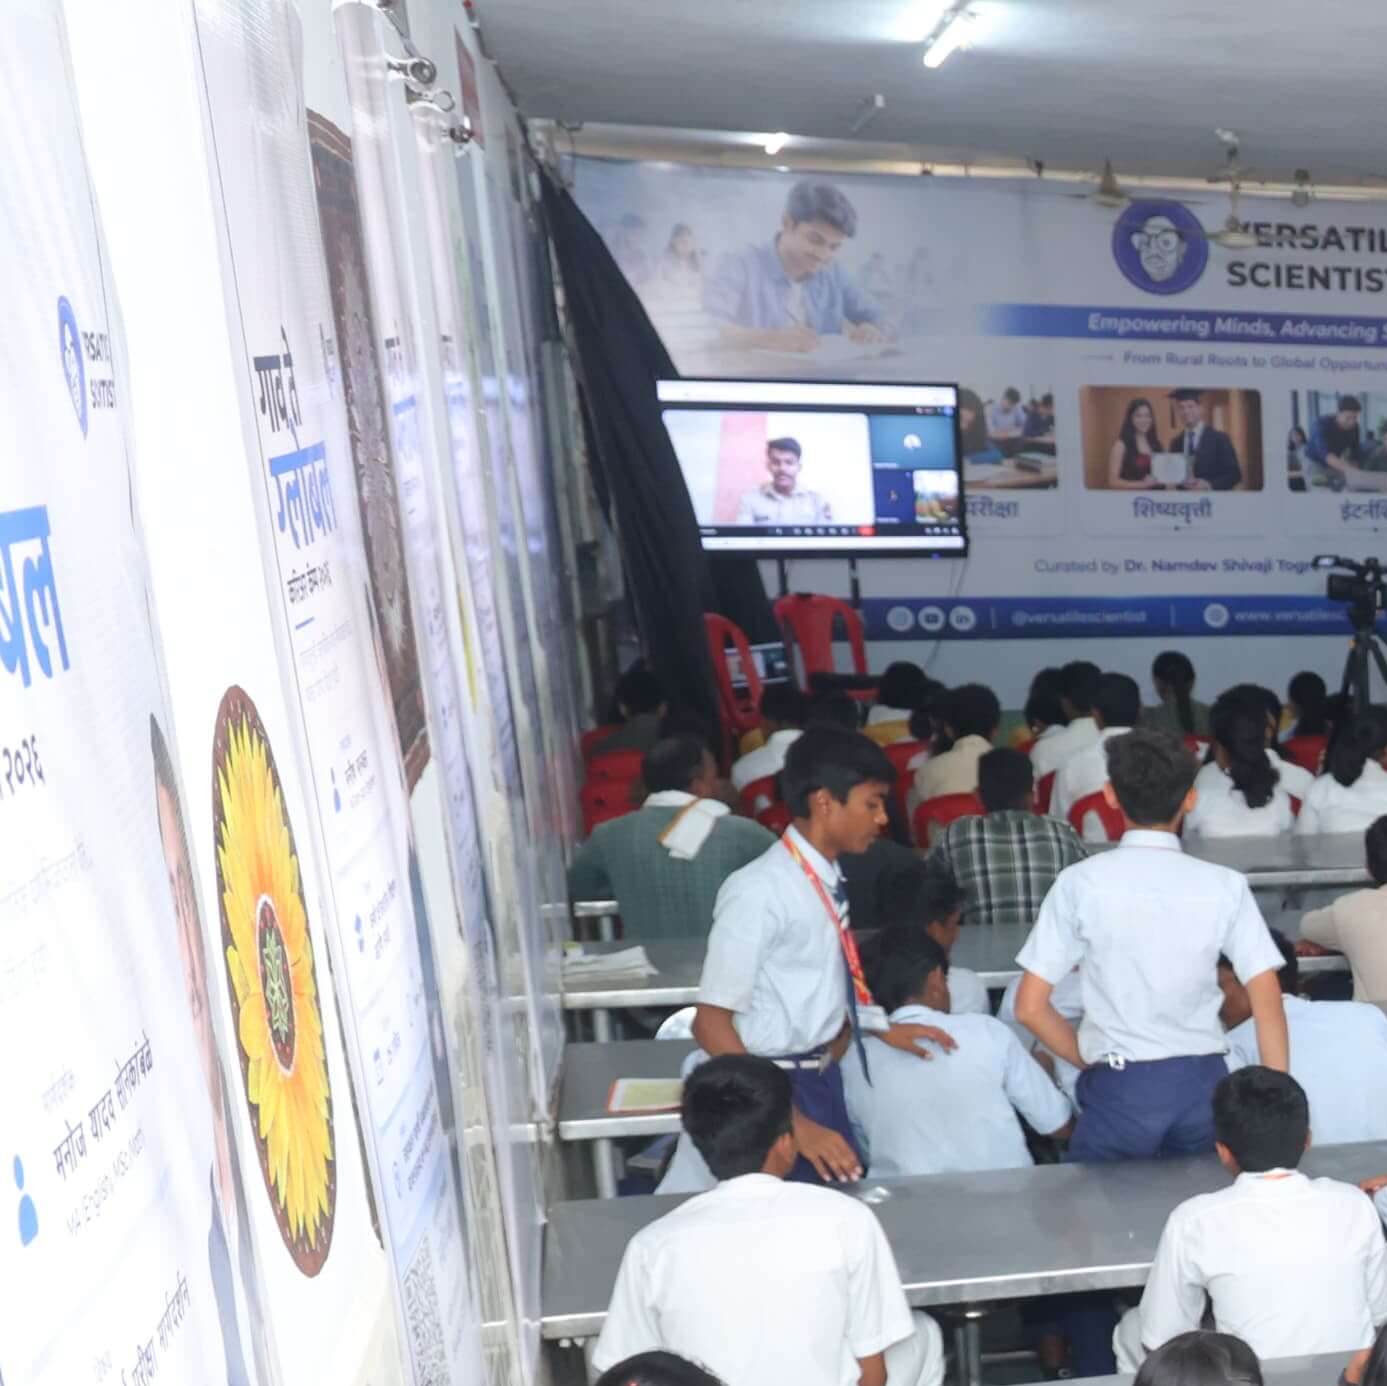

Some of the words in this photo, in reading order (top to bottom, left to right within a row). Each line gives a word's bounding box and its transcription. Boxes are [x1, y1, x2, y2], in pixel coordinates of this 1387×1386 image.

[1087, 312, 1210, 338] Empowering
[1214, 316, 1276, 337] Minds,
[1281, 319, 1378, 343] Advancing
[1123, 351, 1162, 365] From
[1165, 351, 1203, 366] Rural
[1207, 353, 1248, 368] Roots
[1252, 354, 1267, 368] to
[1271, 355, 1316, 370] Global
[252, 354, 290, 433] गाव
[267, 416, 338, 550] ग्लोबल
[1034, 559, 1097, 573] Curated
[1101, 558, 1119, 575] by
[1124, 559, 1147, 573] Dr.
[1151, 559, 1217, 573] Namdev
[53, 1119, 88, 1181] मनोज
[88, 1088, 116, 1143] यादव
